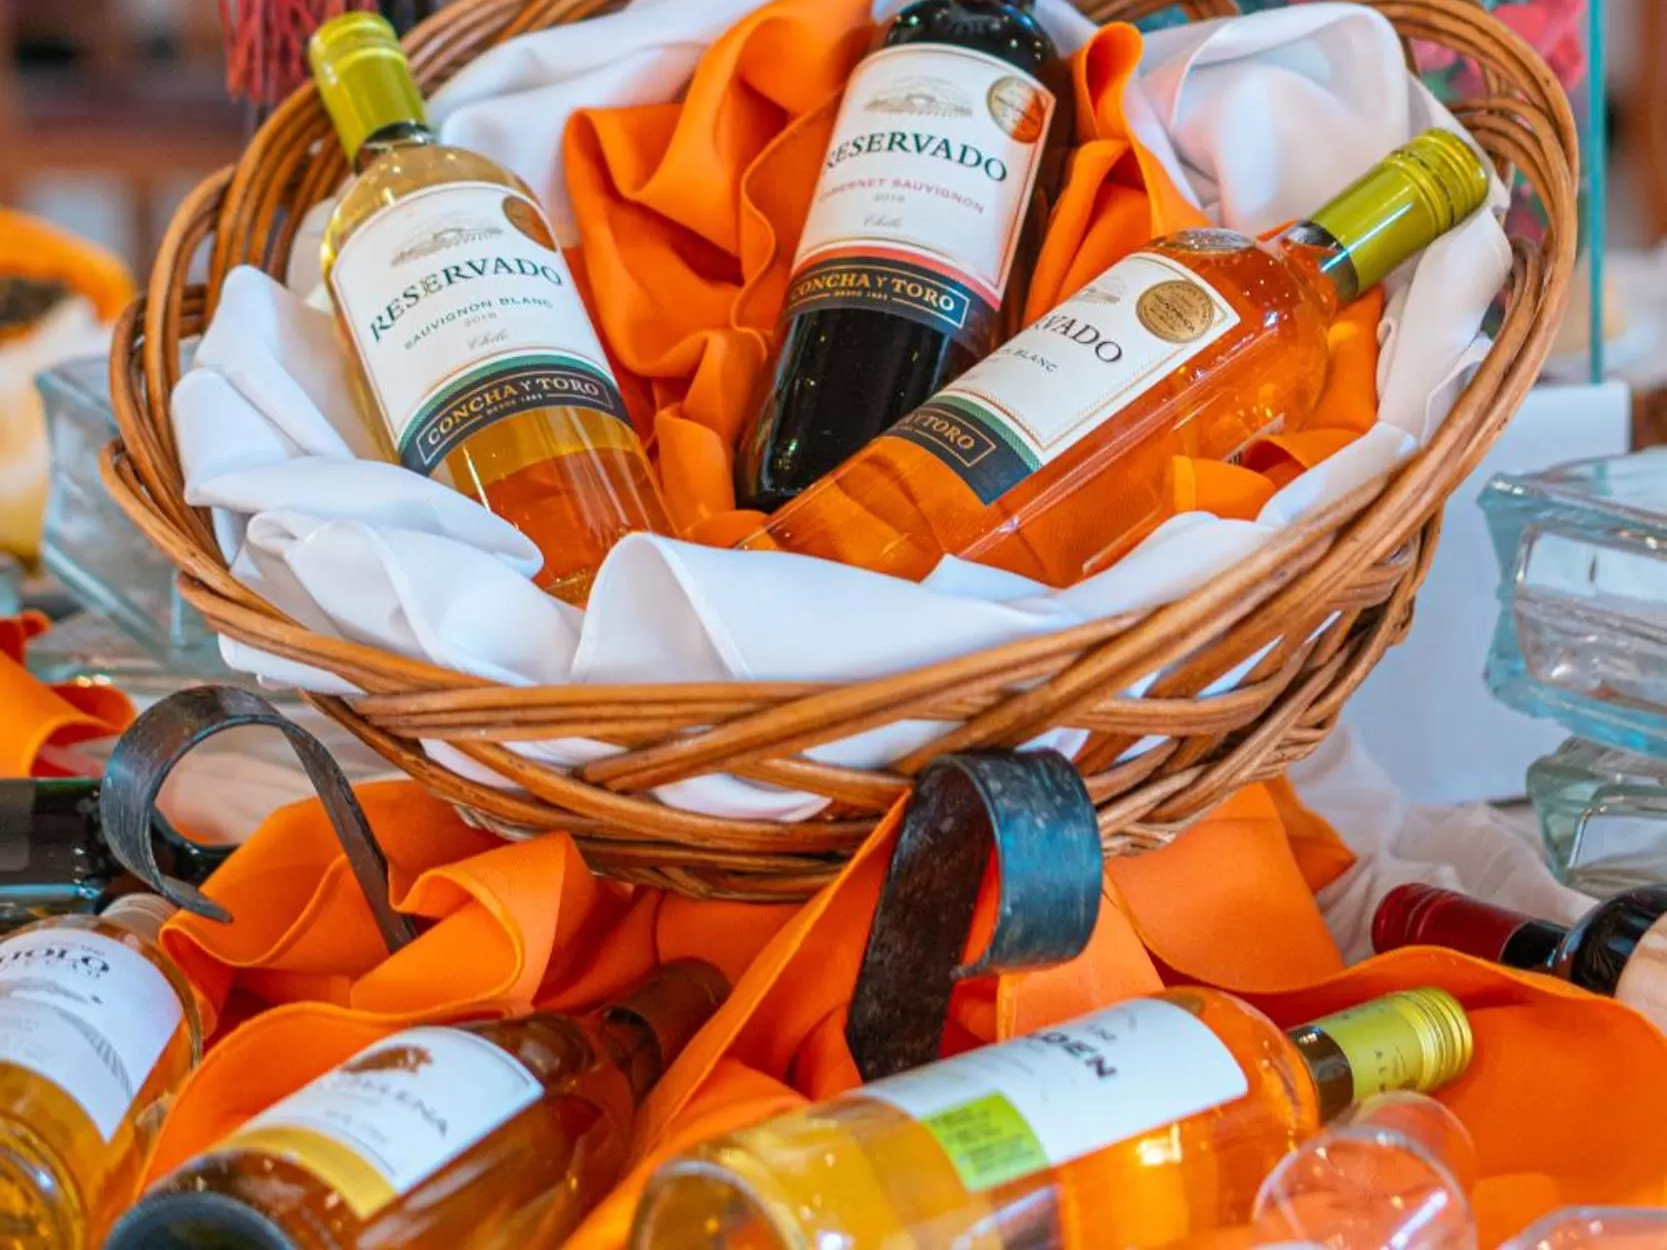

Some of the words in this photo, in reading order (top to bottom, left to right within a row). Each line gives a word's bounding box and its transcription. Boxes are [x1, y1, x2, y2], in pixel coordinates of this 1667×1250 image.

[892, 178, 985, 215] SAUVIGNON
[369, 257, 564, 343] RESERVADO
[875, 275, 888, 288] Y
[891, 277, 954, 311] TORO
[404, 299, 492, 350] SAUVIGNON
[428, 383, 518, 445] CONCHA
[519, 379, 533, 392] Y
[535, 376, 600, 397] TORO
[922, 415, 975, 450] TORO
